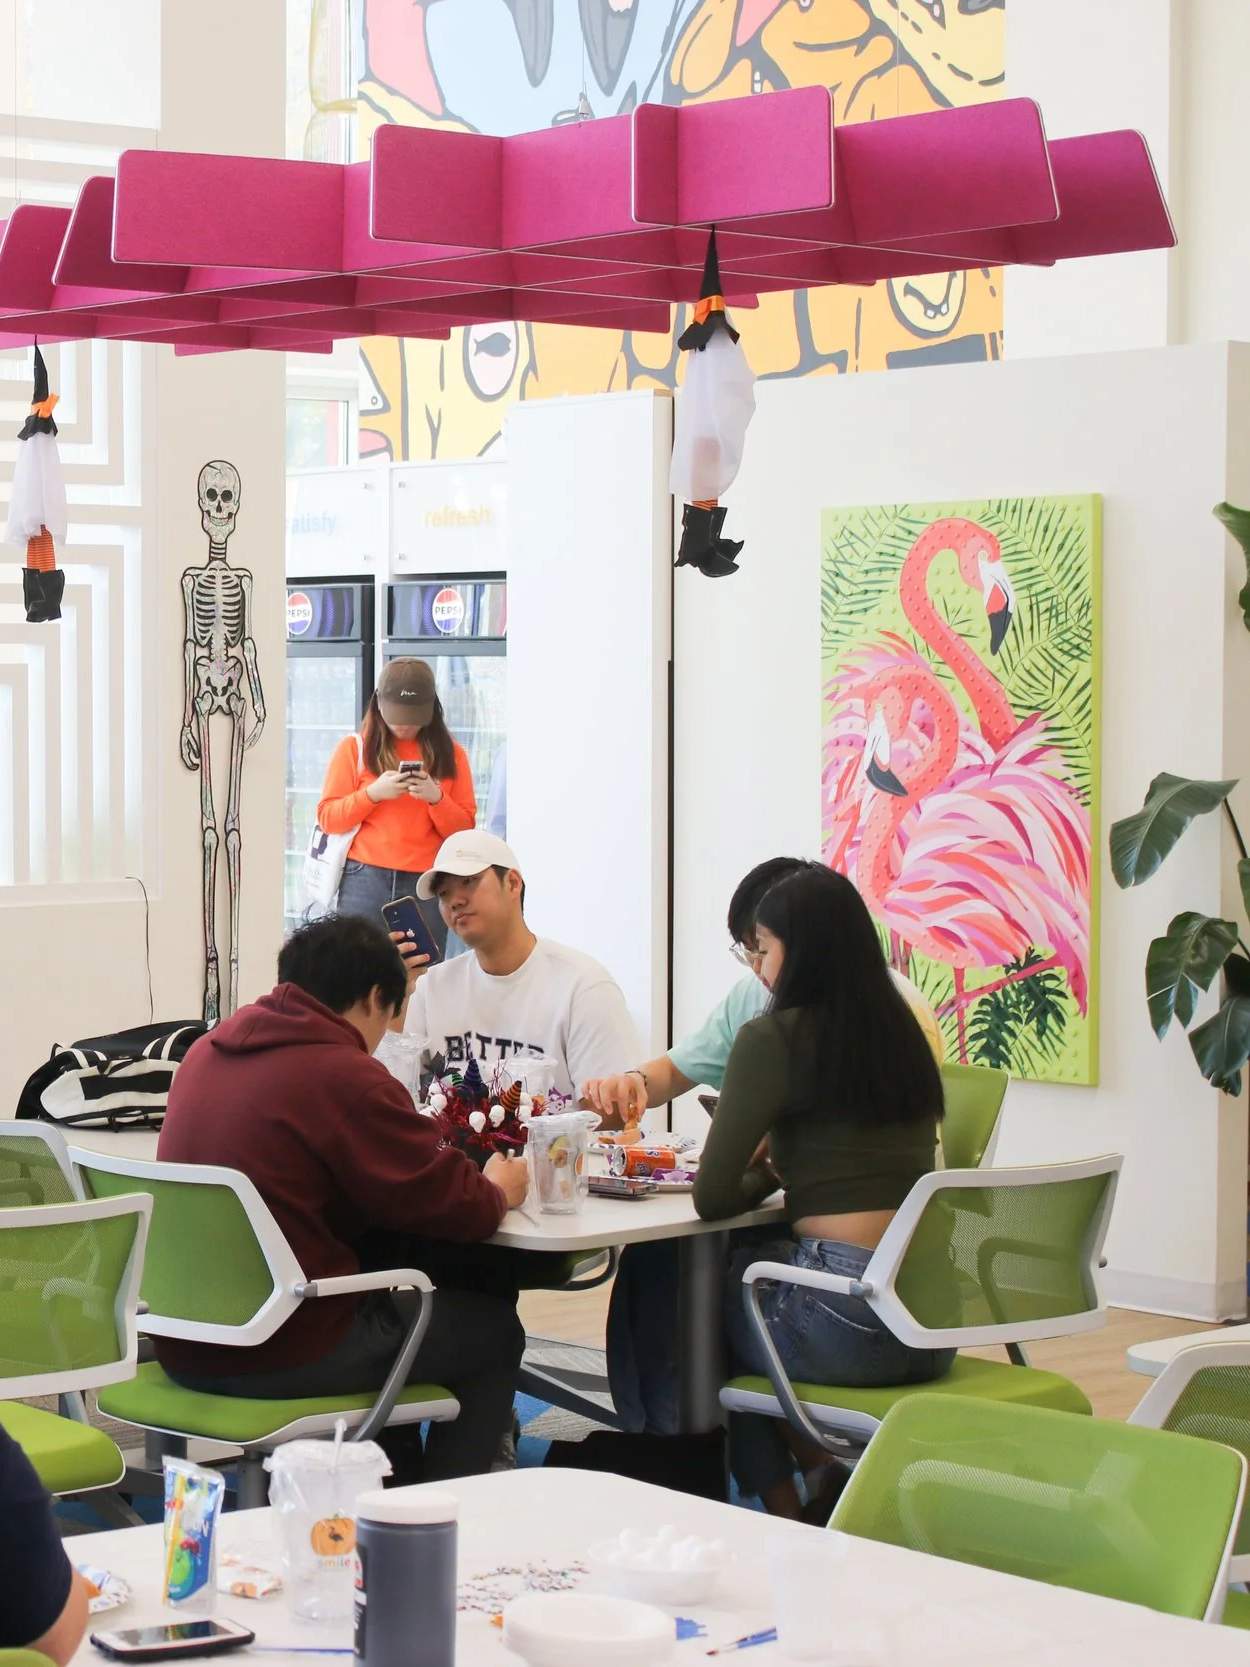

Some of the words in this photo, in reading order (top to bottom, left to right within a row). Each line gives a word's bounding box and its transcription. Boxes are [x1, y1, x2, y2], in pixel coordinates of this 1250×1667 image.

[287, 509, 337, 536] atisfy
[424, 504, 491, 528] refresh
[435, 606, 461, 615] PEPSI
[444, 1030, 545, 1061] BETT
